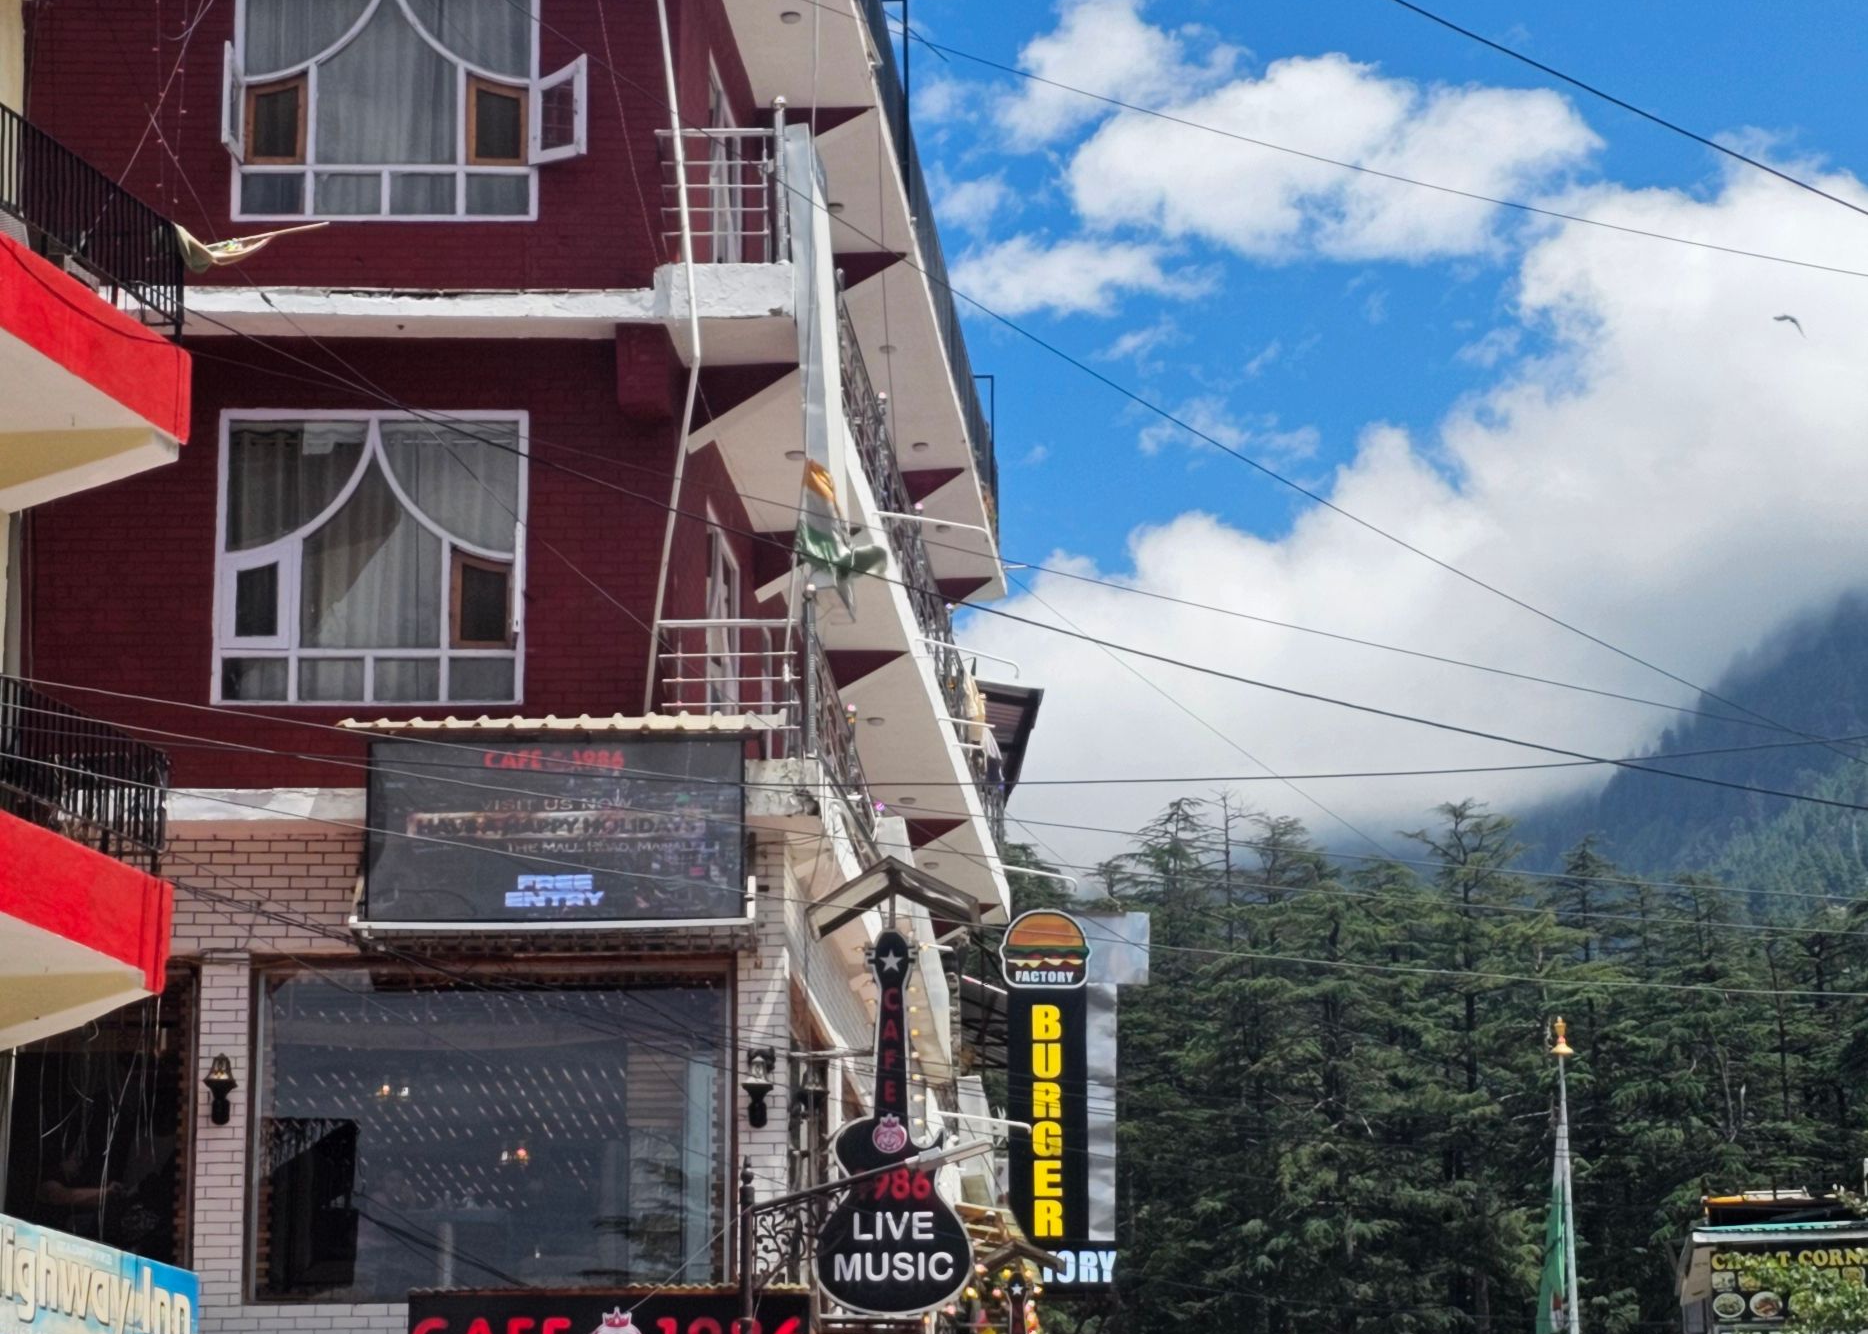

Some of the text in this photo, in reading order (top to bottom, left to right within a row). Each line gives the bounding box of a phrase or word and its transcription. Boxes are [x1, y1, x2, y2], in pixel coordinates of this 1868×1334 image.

[484, 748, 625, 771] CAFE 1986
[544, 798, 573, 813] US
[507, 841, 538, 853] THE
[542, 841, 585, 853] MALL
[517, 874, 593, 890] FREE
[505, 891, 605, 907] ENTRY
[1015, 970, 1074, 984] FACTORY
[882, 986, 900, 1103] CAFE
[1031, 1004, 1064, 1238] BURGER
[852, 1211, 935, 1241] LIVE
[833, 1251, 955, 1282] MUSIC
